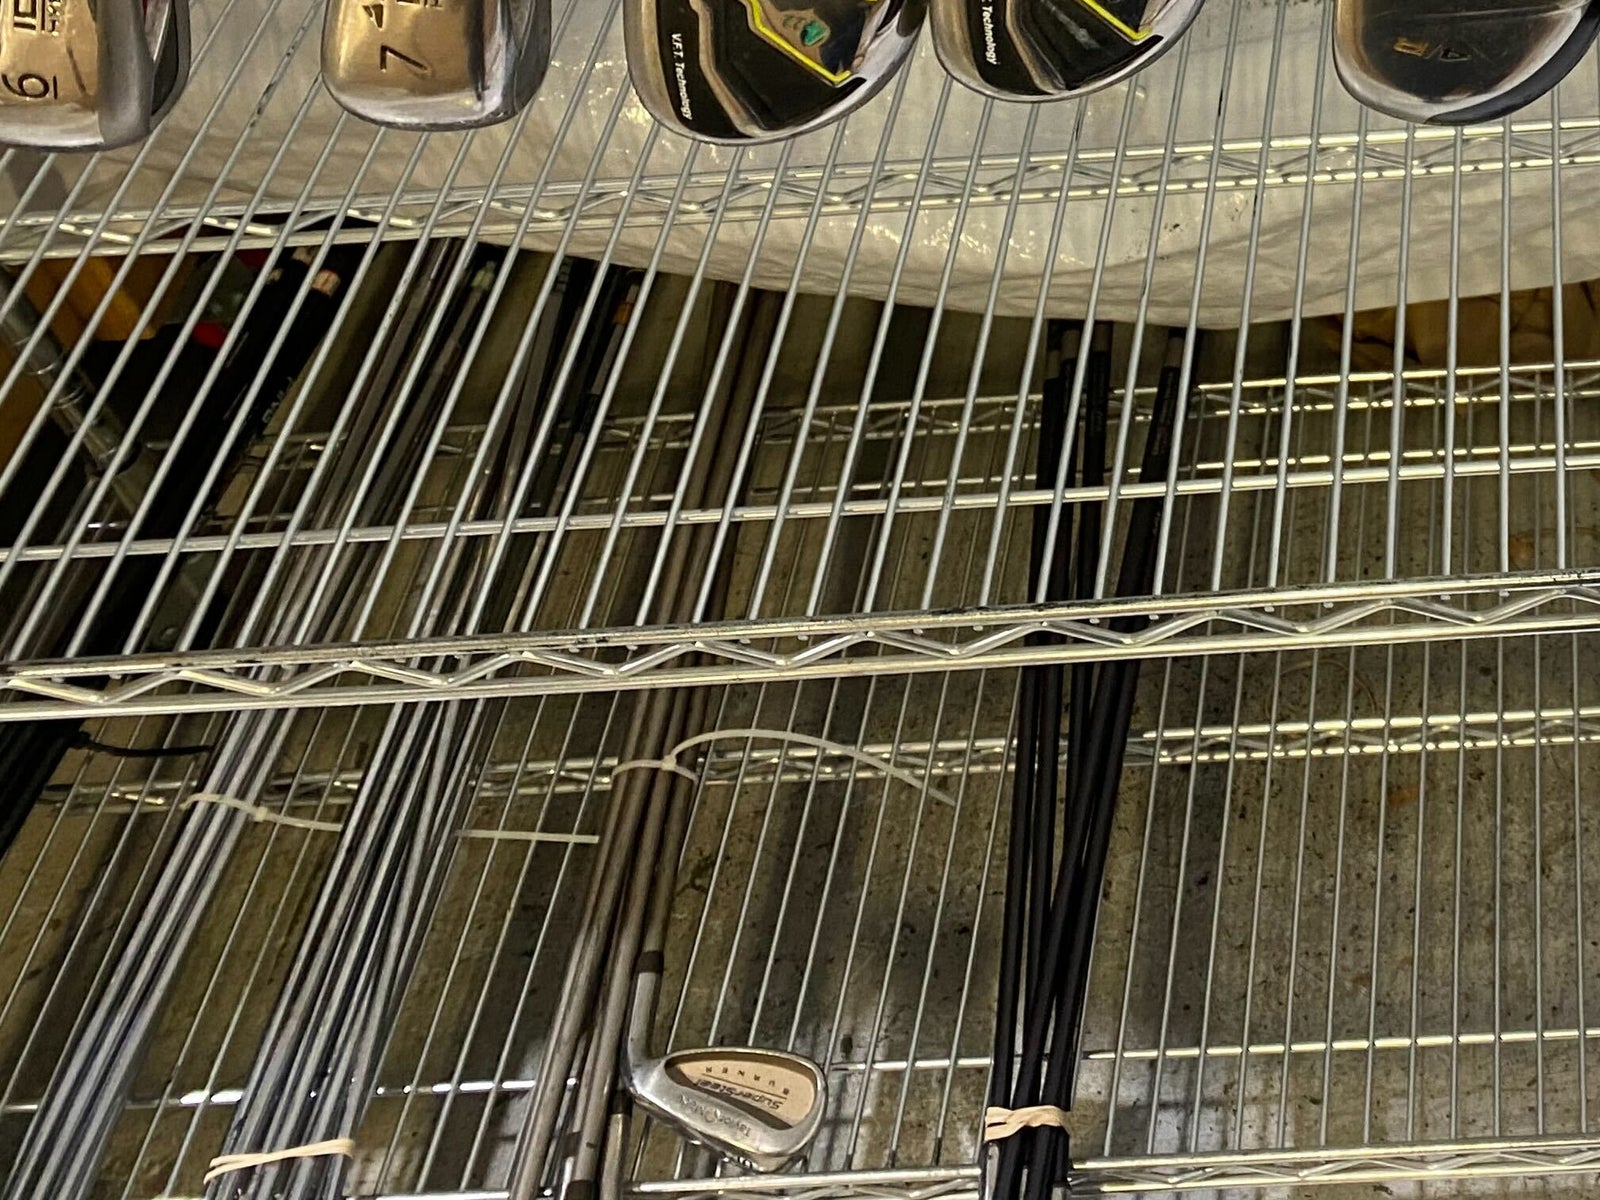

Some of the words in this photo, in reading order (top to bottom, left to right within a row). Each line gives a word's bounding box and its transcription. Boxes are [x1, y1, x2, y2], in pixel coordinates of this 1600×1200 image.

[981, 5, 998, 66] Technology
[378, 43, 432, 75] 7
[1, 72, 50, 100] 6
[674, 62, 693, 121] Technology
